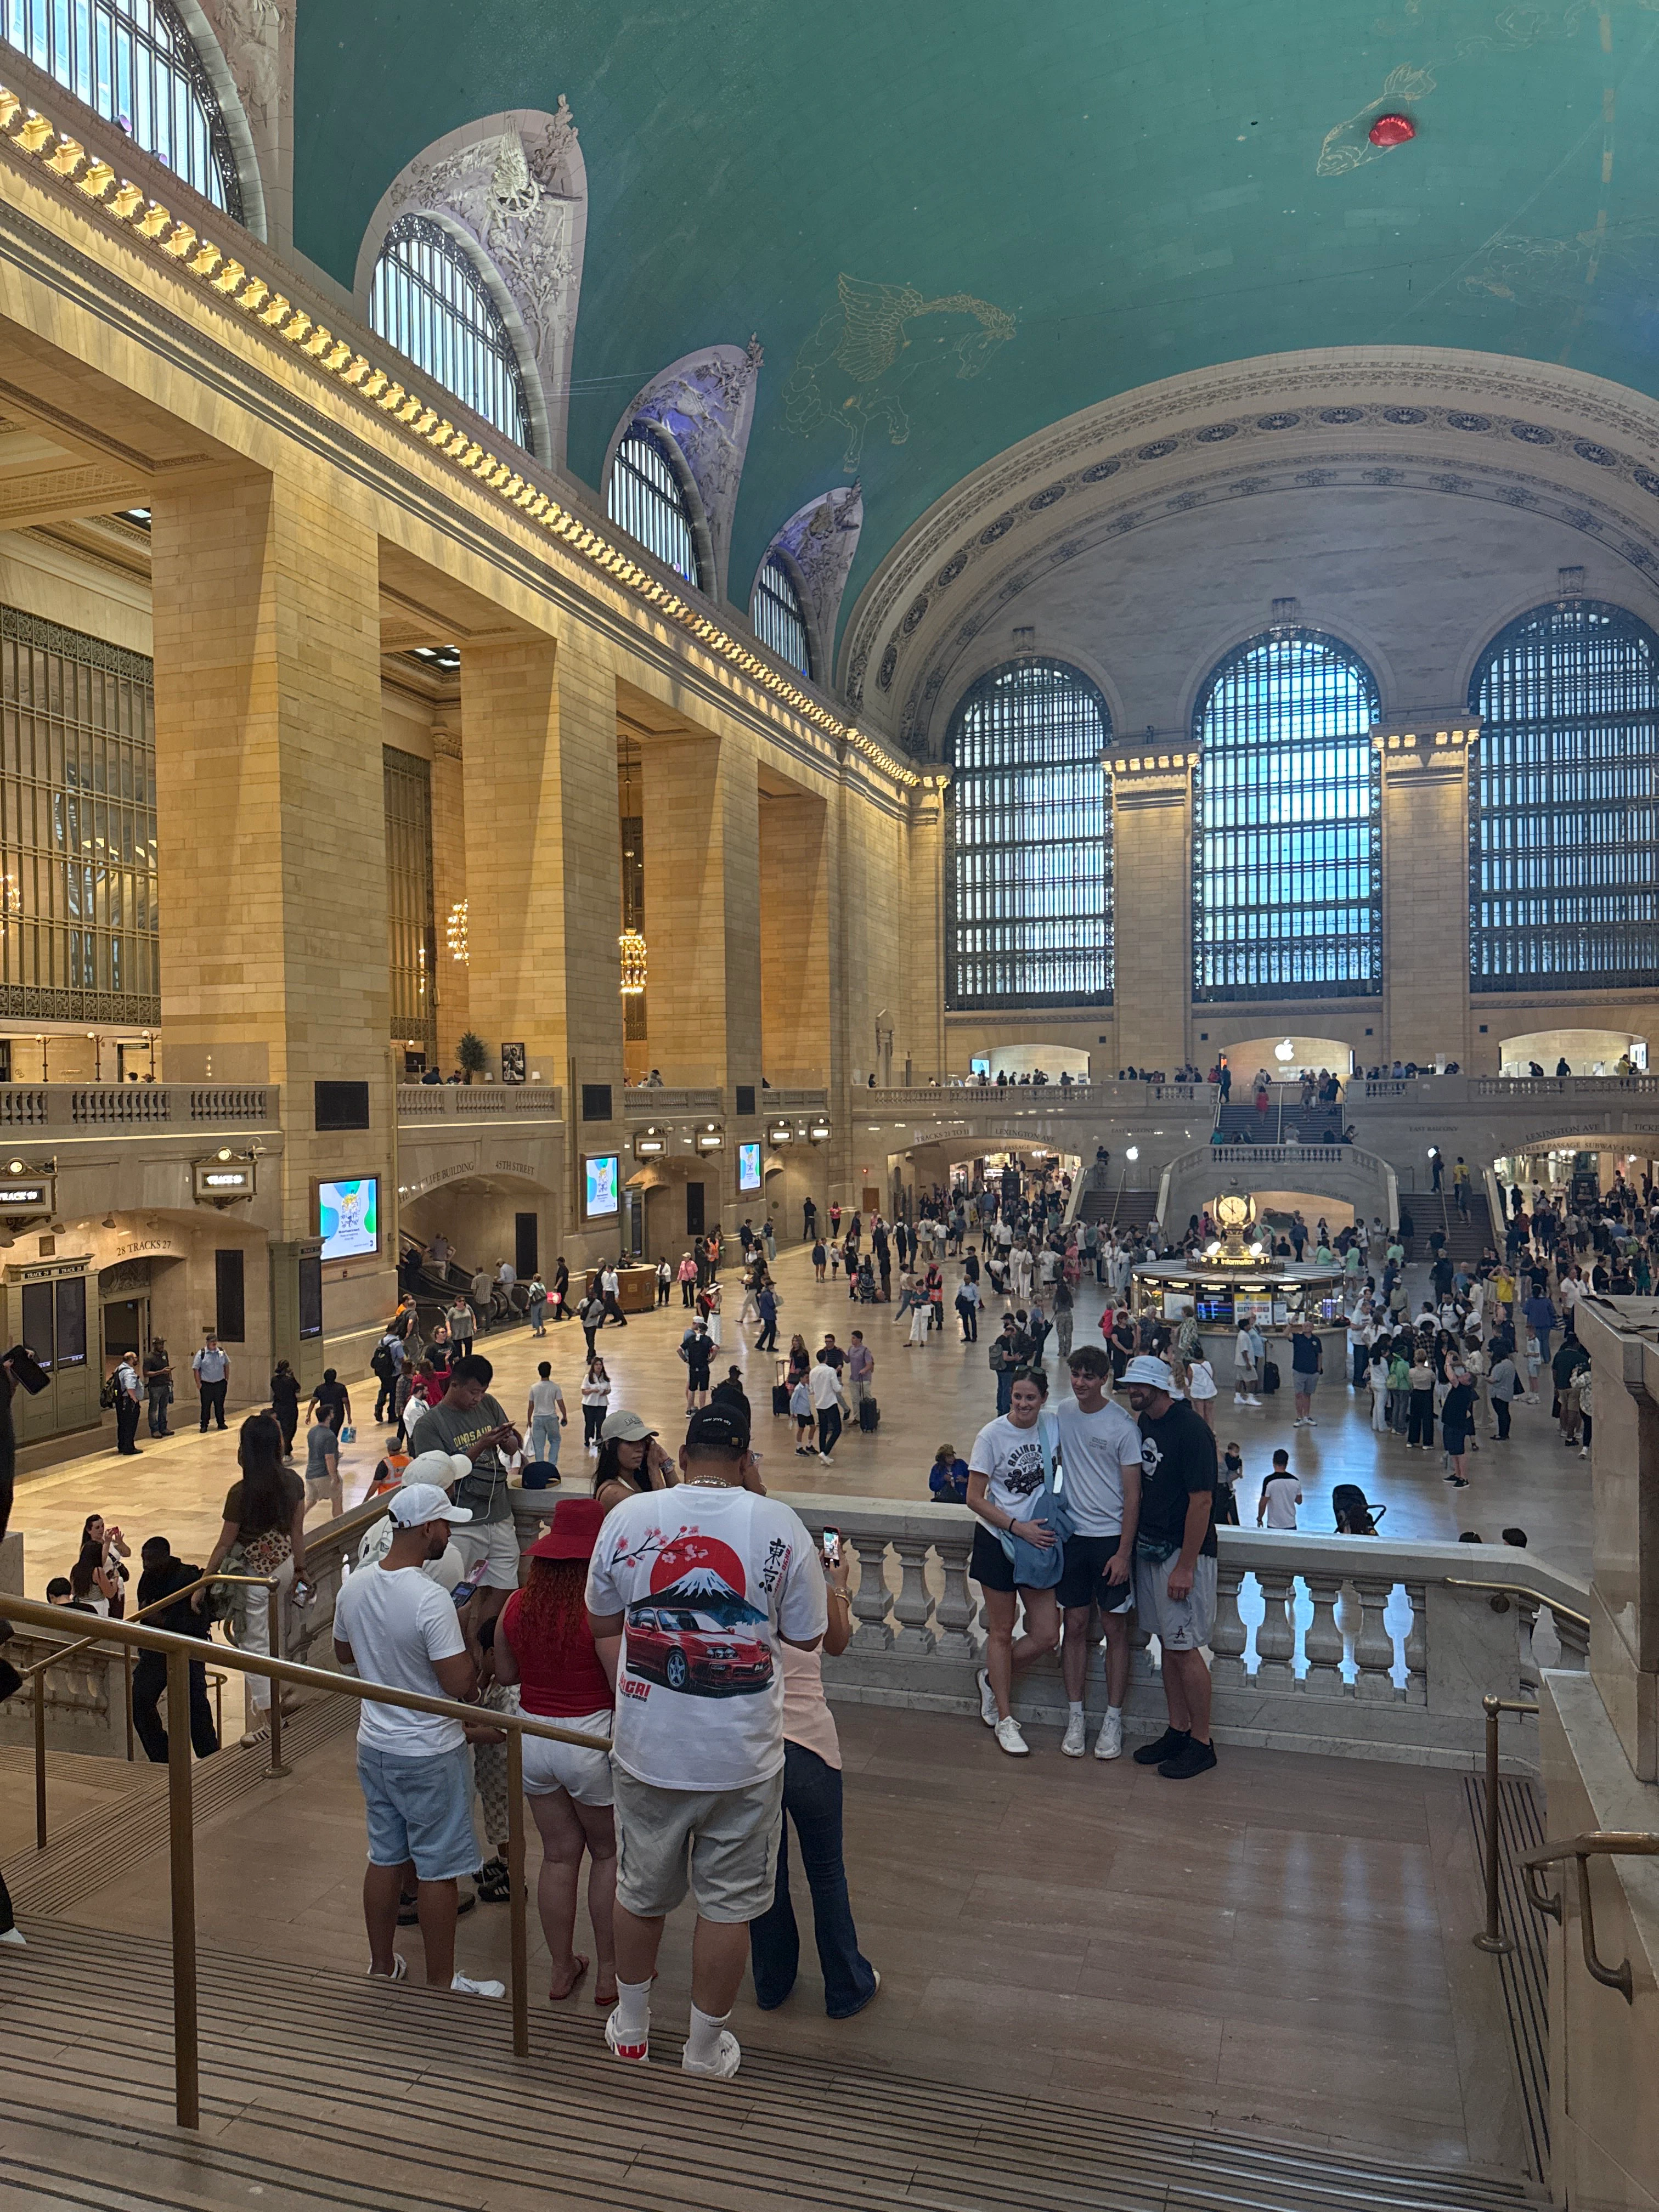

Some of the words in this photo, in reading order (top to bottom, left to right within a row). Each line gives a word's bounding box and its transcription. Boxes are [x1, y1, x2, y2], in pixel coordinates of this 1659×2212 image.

[916, 1132, 943, 1143] TRACKS
[995, 1128, 1039, 1139] LEXINGTON
[1526, 1126, 1579, 1141] LEXINGTON
[1583, 1124, 1599, 1132] AVE
[1517, 1144, 1545, 1152] STREET
[1585, 1142, 1618, 1150] SUBWAY
[495, 1160, 511, 1170] 45TH
[512, 1162, 535, 1176] STREET
[398, 1192, 409, 1204] HE
[442, 1161, 475, 1179] BUILDING
[116, 1246, 126, 1256] 28
[127, 1240, 161, 1253] TRACKS
[162, 1240, 171, 1249] 27
[759, 1538, 786, 1594] 東京
